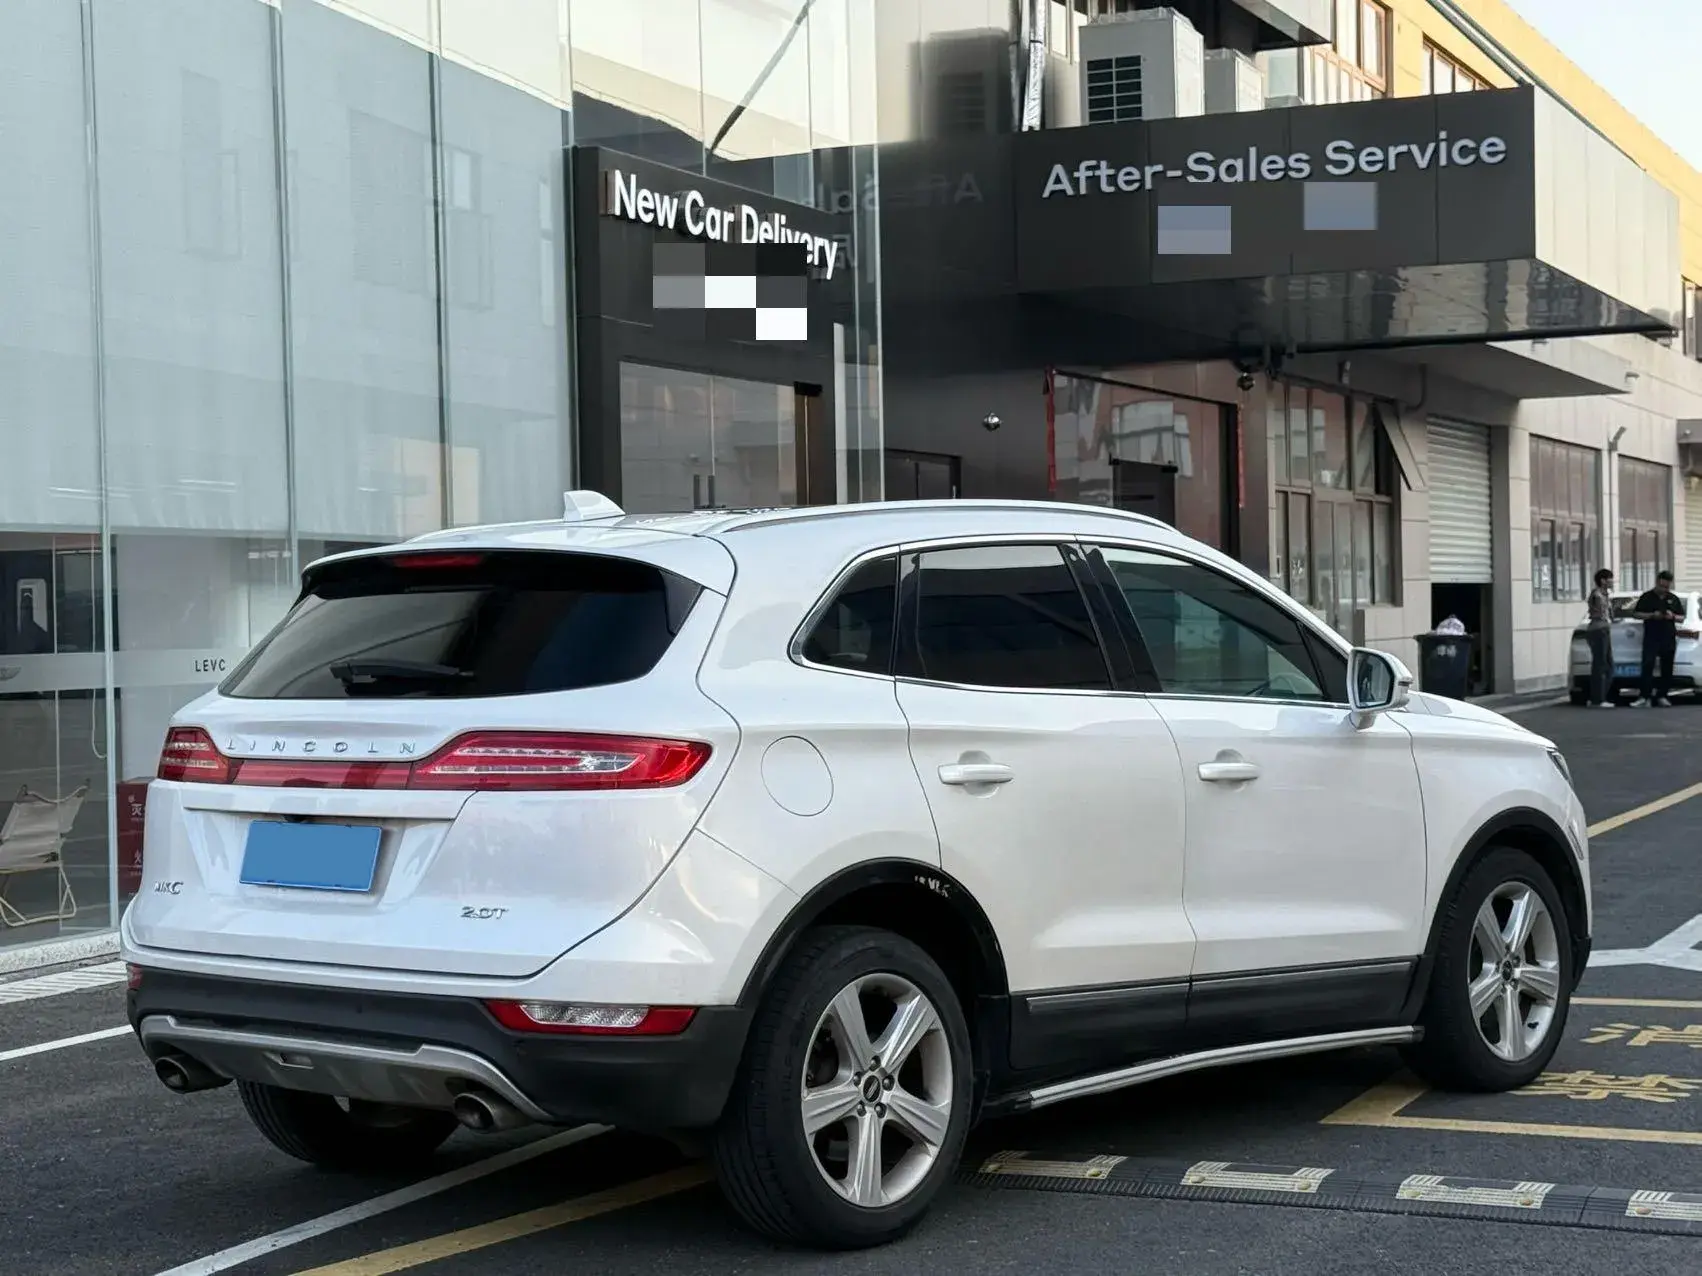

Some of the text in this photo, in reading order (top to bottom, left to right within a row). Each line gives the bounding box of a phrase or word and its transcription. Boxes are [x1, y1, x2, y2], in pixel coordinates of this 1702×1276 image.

[1042, 146, 1312, 199] After-Sales
[1325, 130, 1507, 176] Service
[614, 169, 679, 230] New
[684, 190, 735, 243] Car
[194, 658, 226, 672] LEVC
[225, 736, 416, 754] LINCOLN
